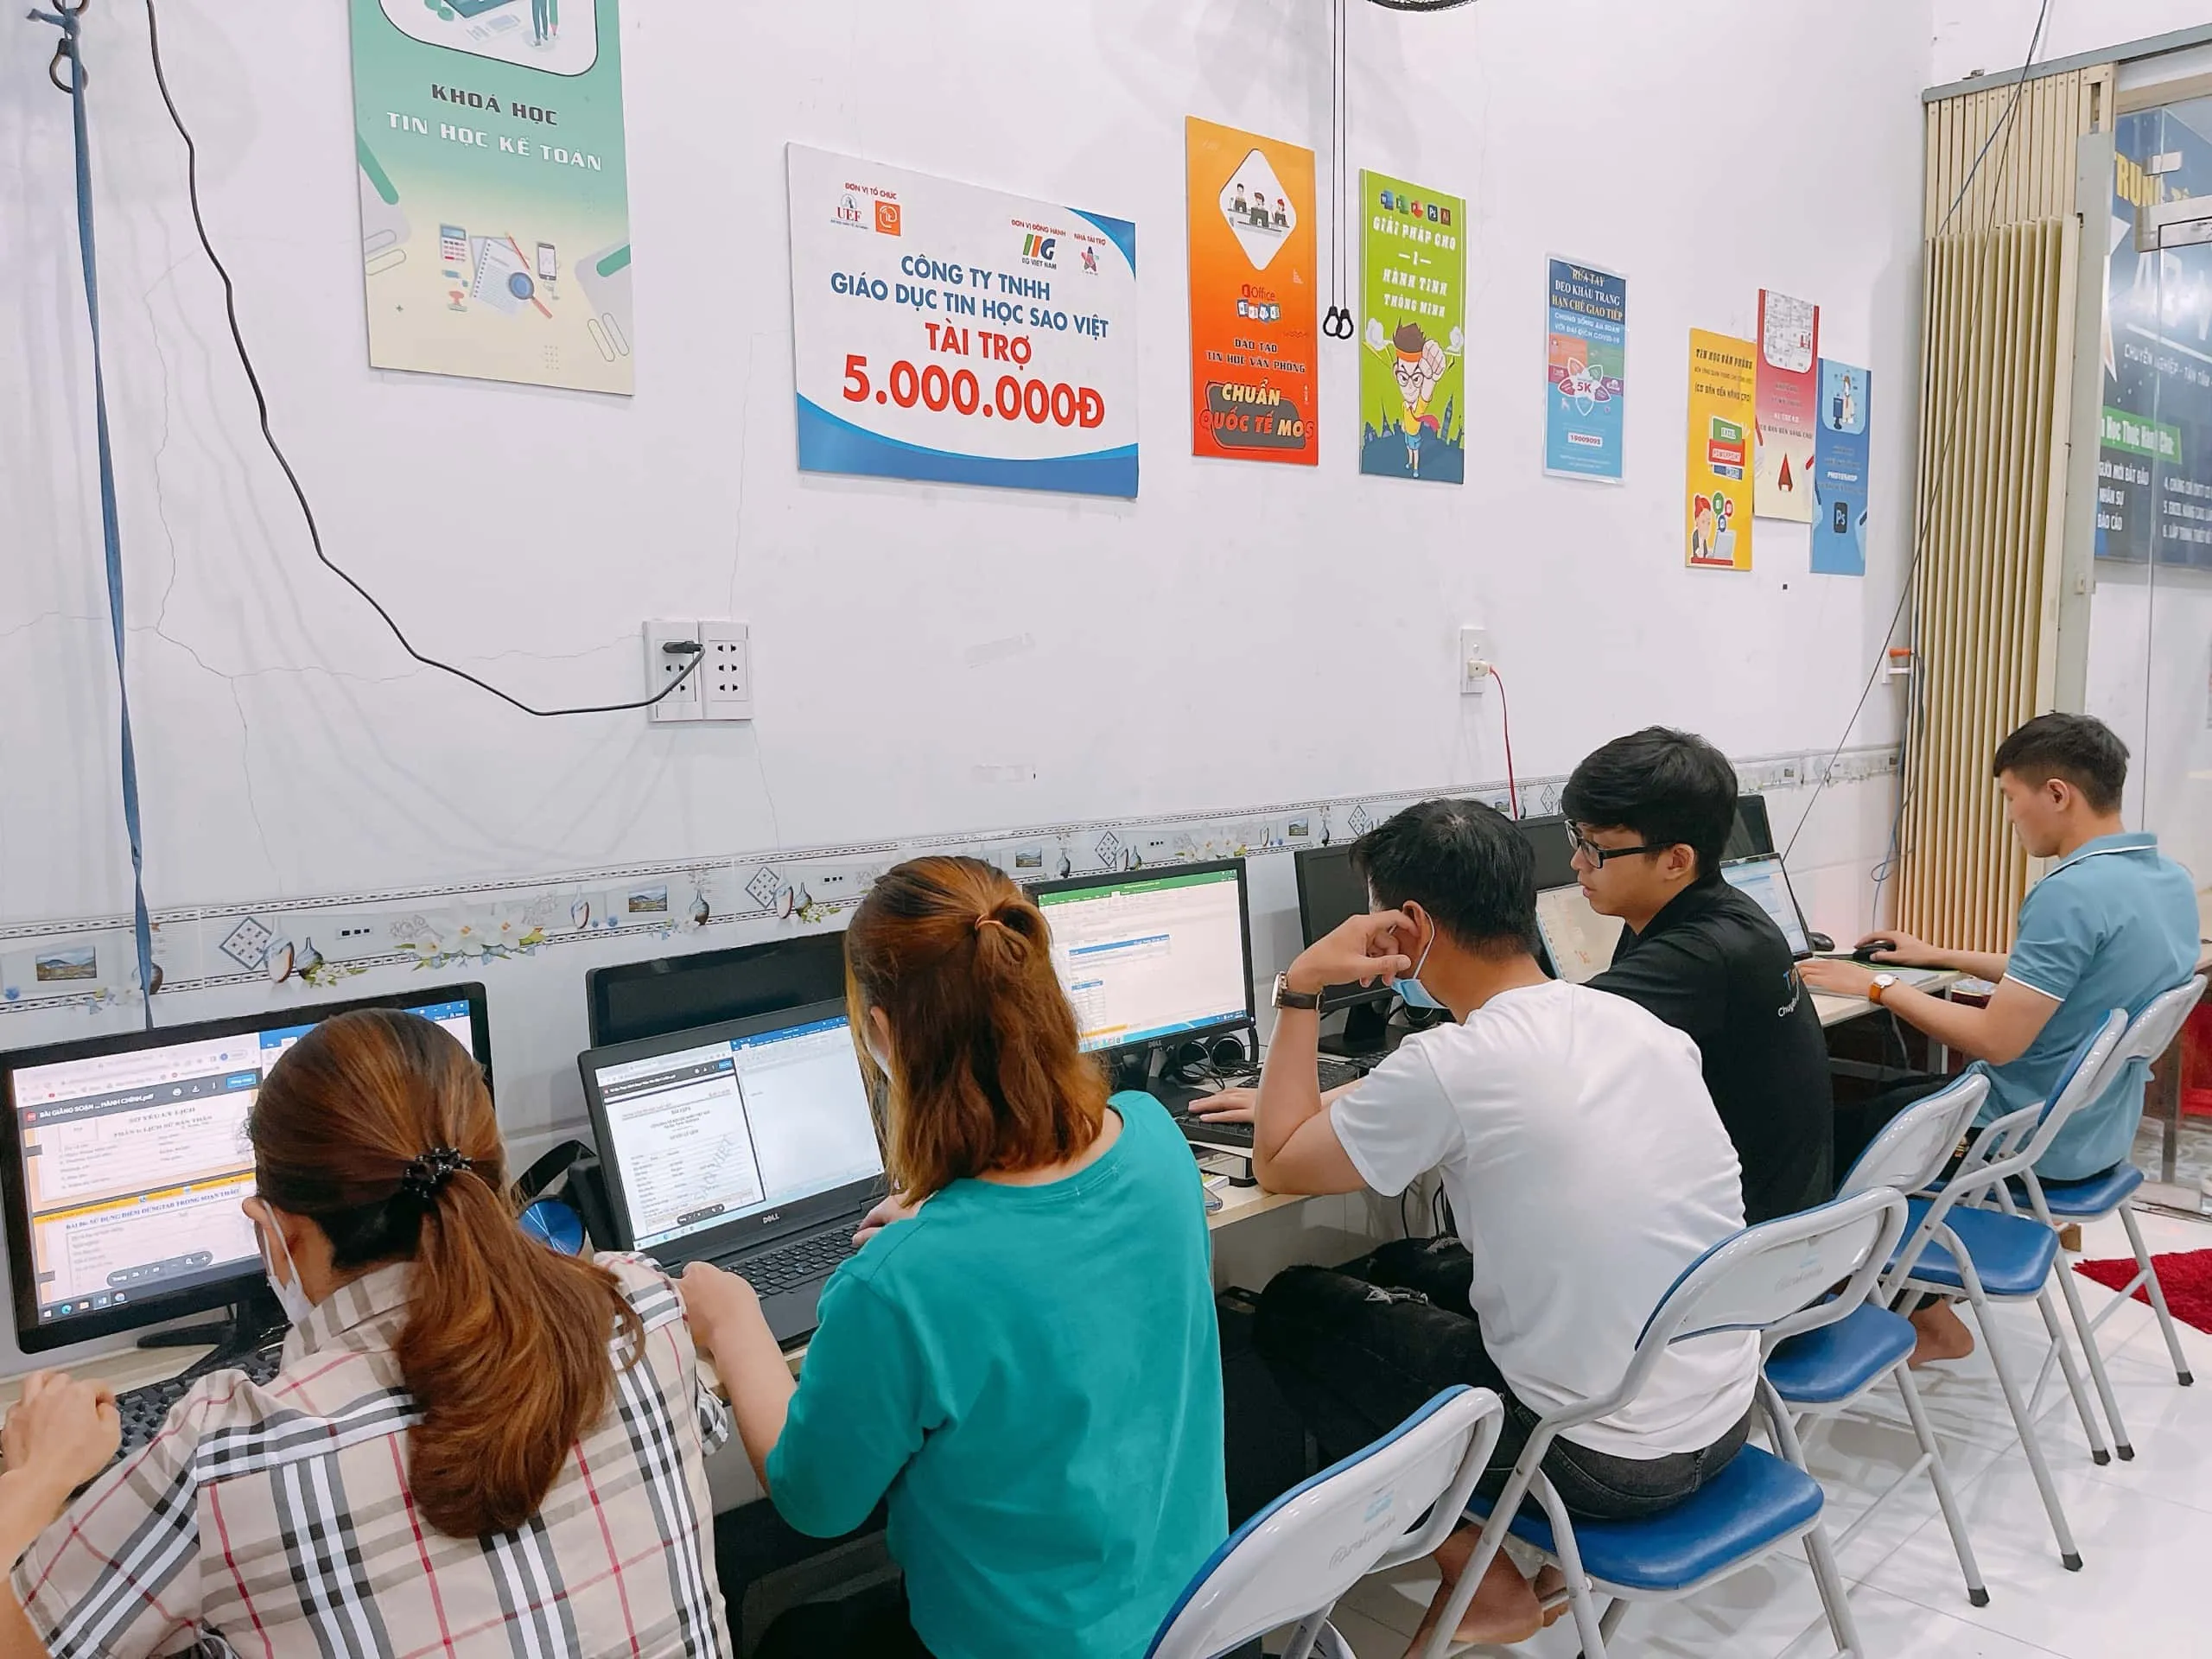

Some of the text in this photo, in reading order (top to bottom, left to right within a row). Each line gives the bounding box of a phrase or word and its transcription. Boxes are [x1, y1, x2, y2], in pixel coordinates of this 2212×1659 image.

[512, 102, 558, 125] HỌC
[387, 111, 429, 134] TIN
[440, 123, 489, 148] HỌC
[837, 207, 862, 222] UEF
[1434, 232, 1456, 251] CHO
[1044, 261, 1057, 270] NAM
[901, 254, 1051, 301] CÔNG TY TNHH
[1251, 286, 1276, 301] Office
[1594, 290, 1620, 306] TRANG
[830, 271, 1109, 340] GIÁO DỤC TIN HỌC SAO VIỆT
[925, 318, 1032, 370] TÀI TRỢ
[843, 353, 1105, 429] 5.000.000Đ
[1222, 378, 1281, 406] CHUẨN
[1577, 382, 1592, 393] 5K
[1199, 406, 1315, 439] QUỐC TẾ MOS
[1836, 510, 1846, 525] Ps
[762, 1214, 780, 1224] DELL
